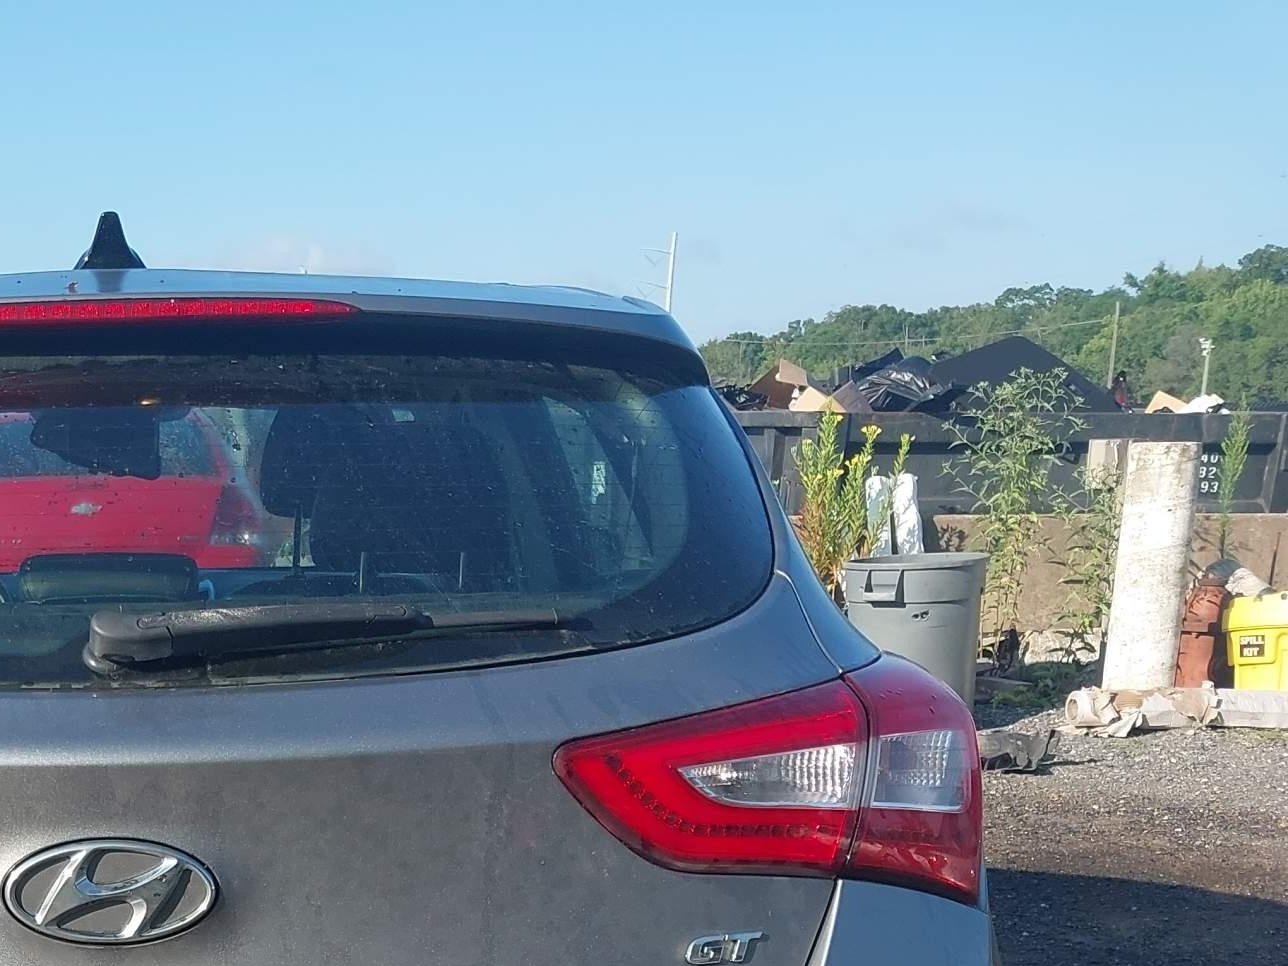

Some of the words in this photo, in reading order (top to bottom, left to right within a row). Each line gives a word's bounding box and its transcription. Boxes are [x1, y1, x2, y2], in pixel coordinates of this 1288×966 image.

[1200, 480, 1219, 493] 93
[1240, 635, 1265, 645] SPILL
[1243, 647, 1260, 657] KIT
[684, 930, 765, 966] GT
